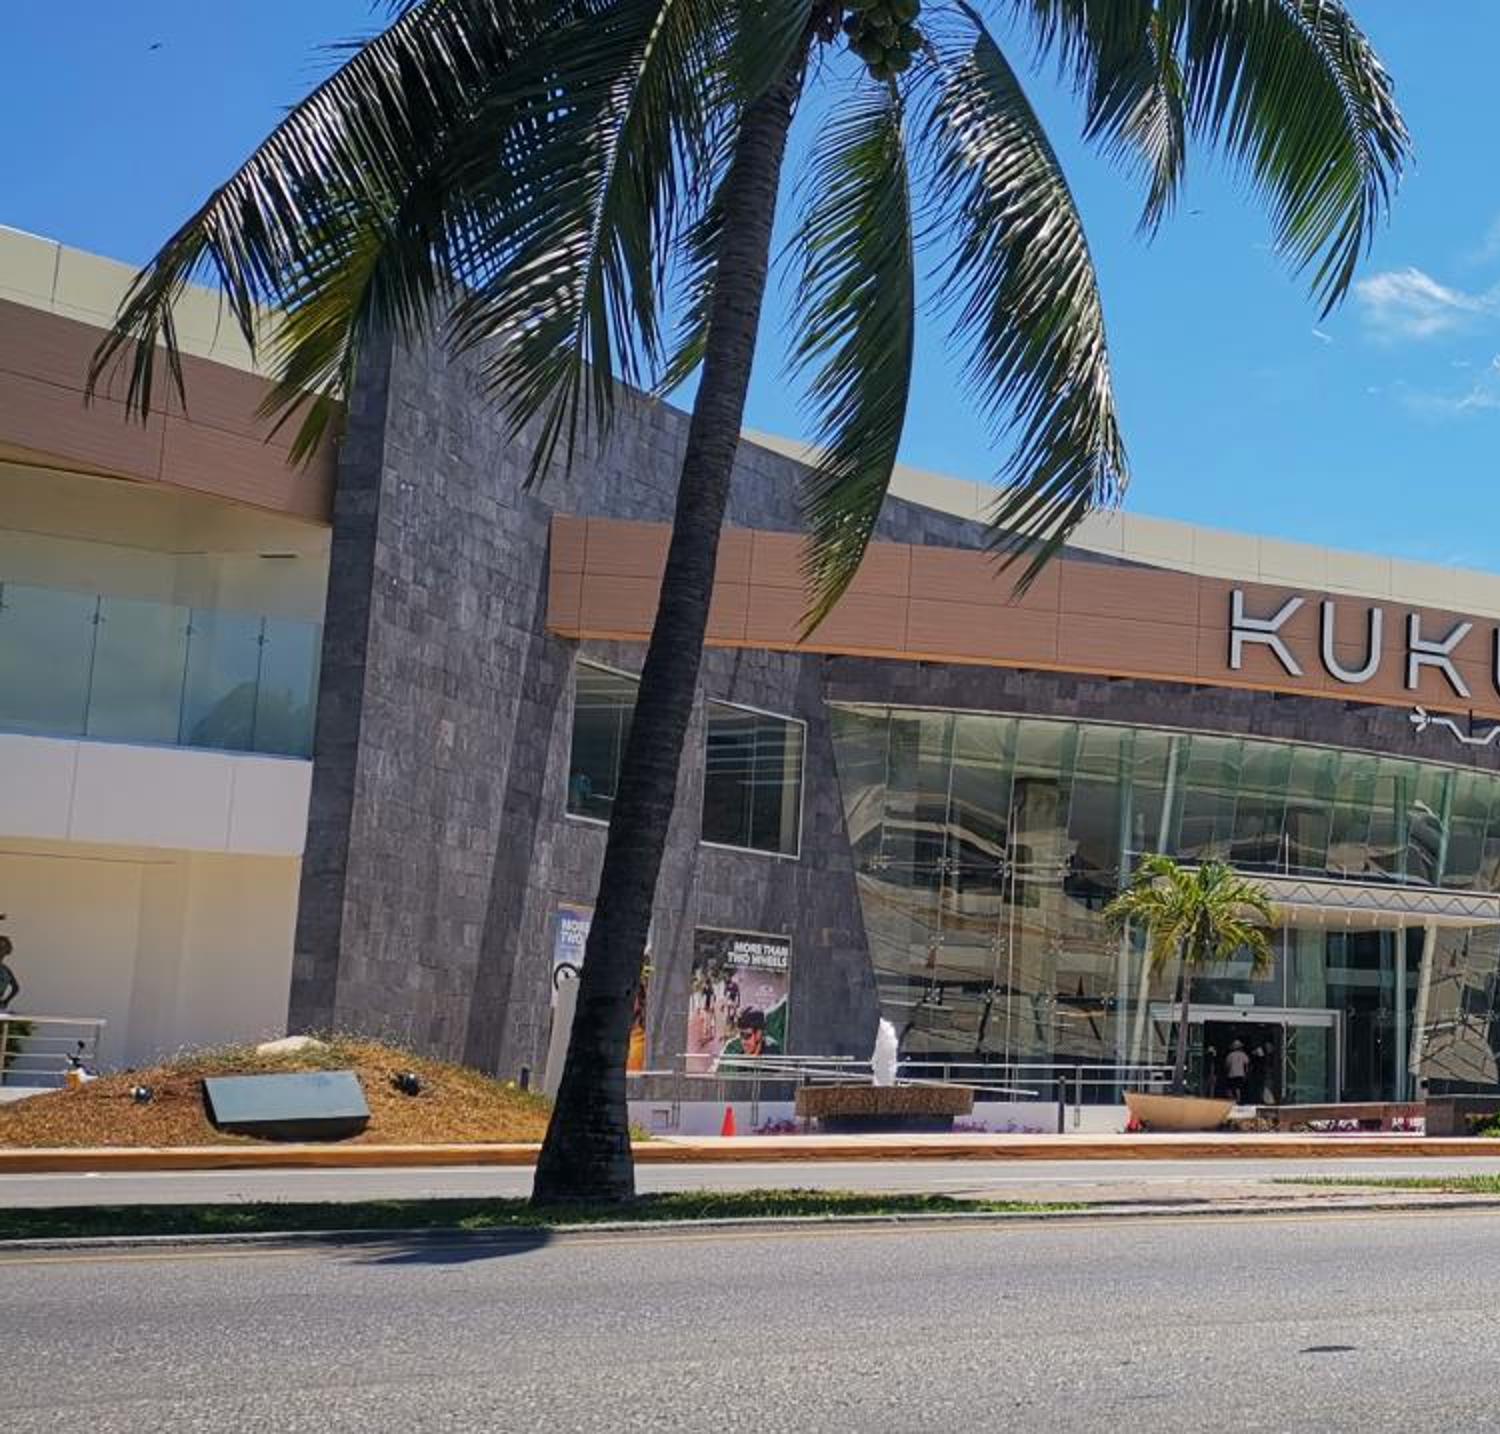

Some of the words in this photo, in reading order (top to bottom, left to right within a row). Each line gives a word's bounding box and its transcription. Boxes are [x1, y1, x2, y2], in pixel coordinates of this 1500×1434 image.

[734, 941, 762, 955] MORE
[763, 945, 788, 957] THAN
[728, 951, 750, 965] TWO
[752, 954, 787, 967] WHEELS
